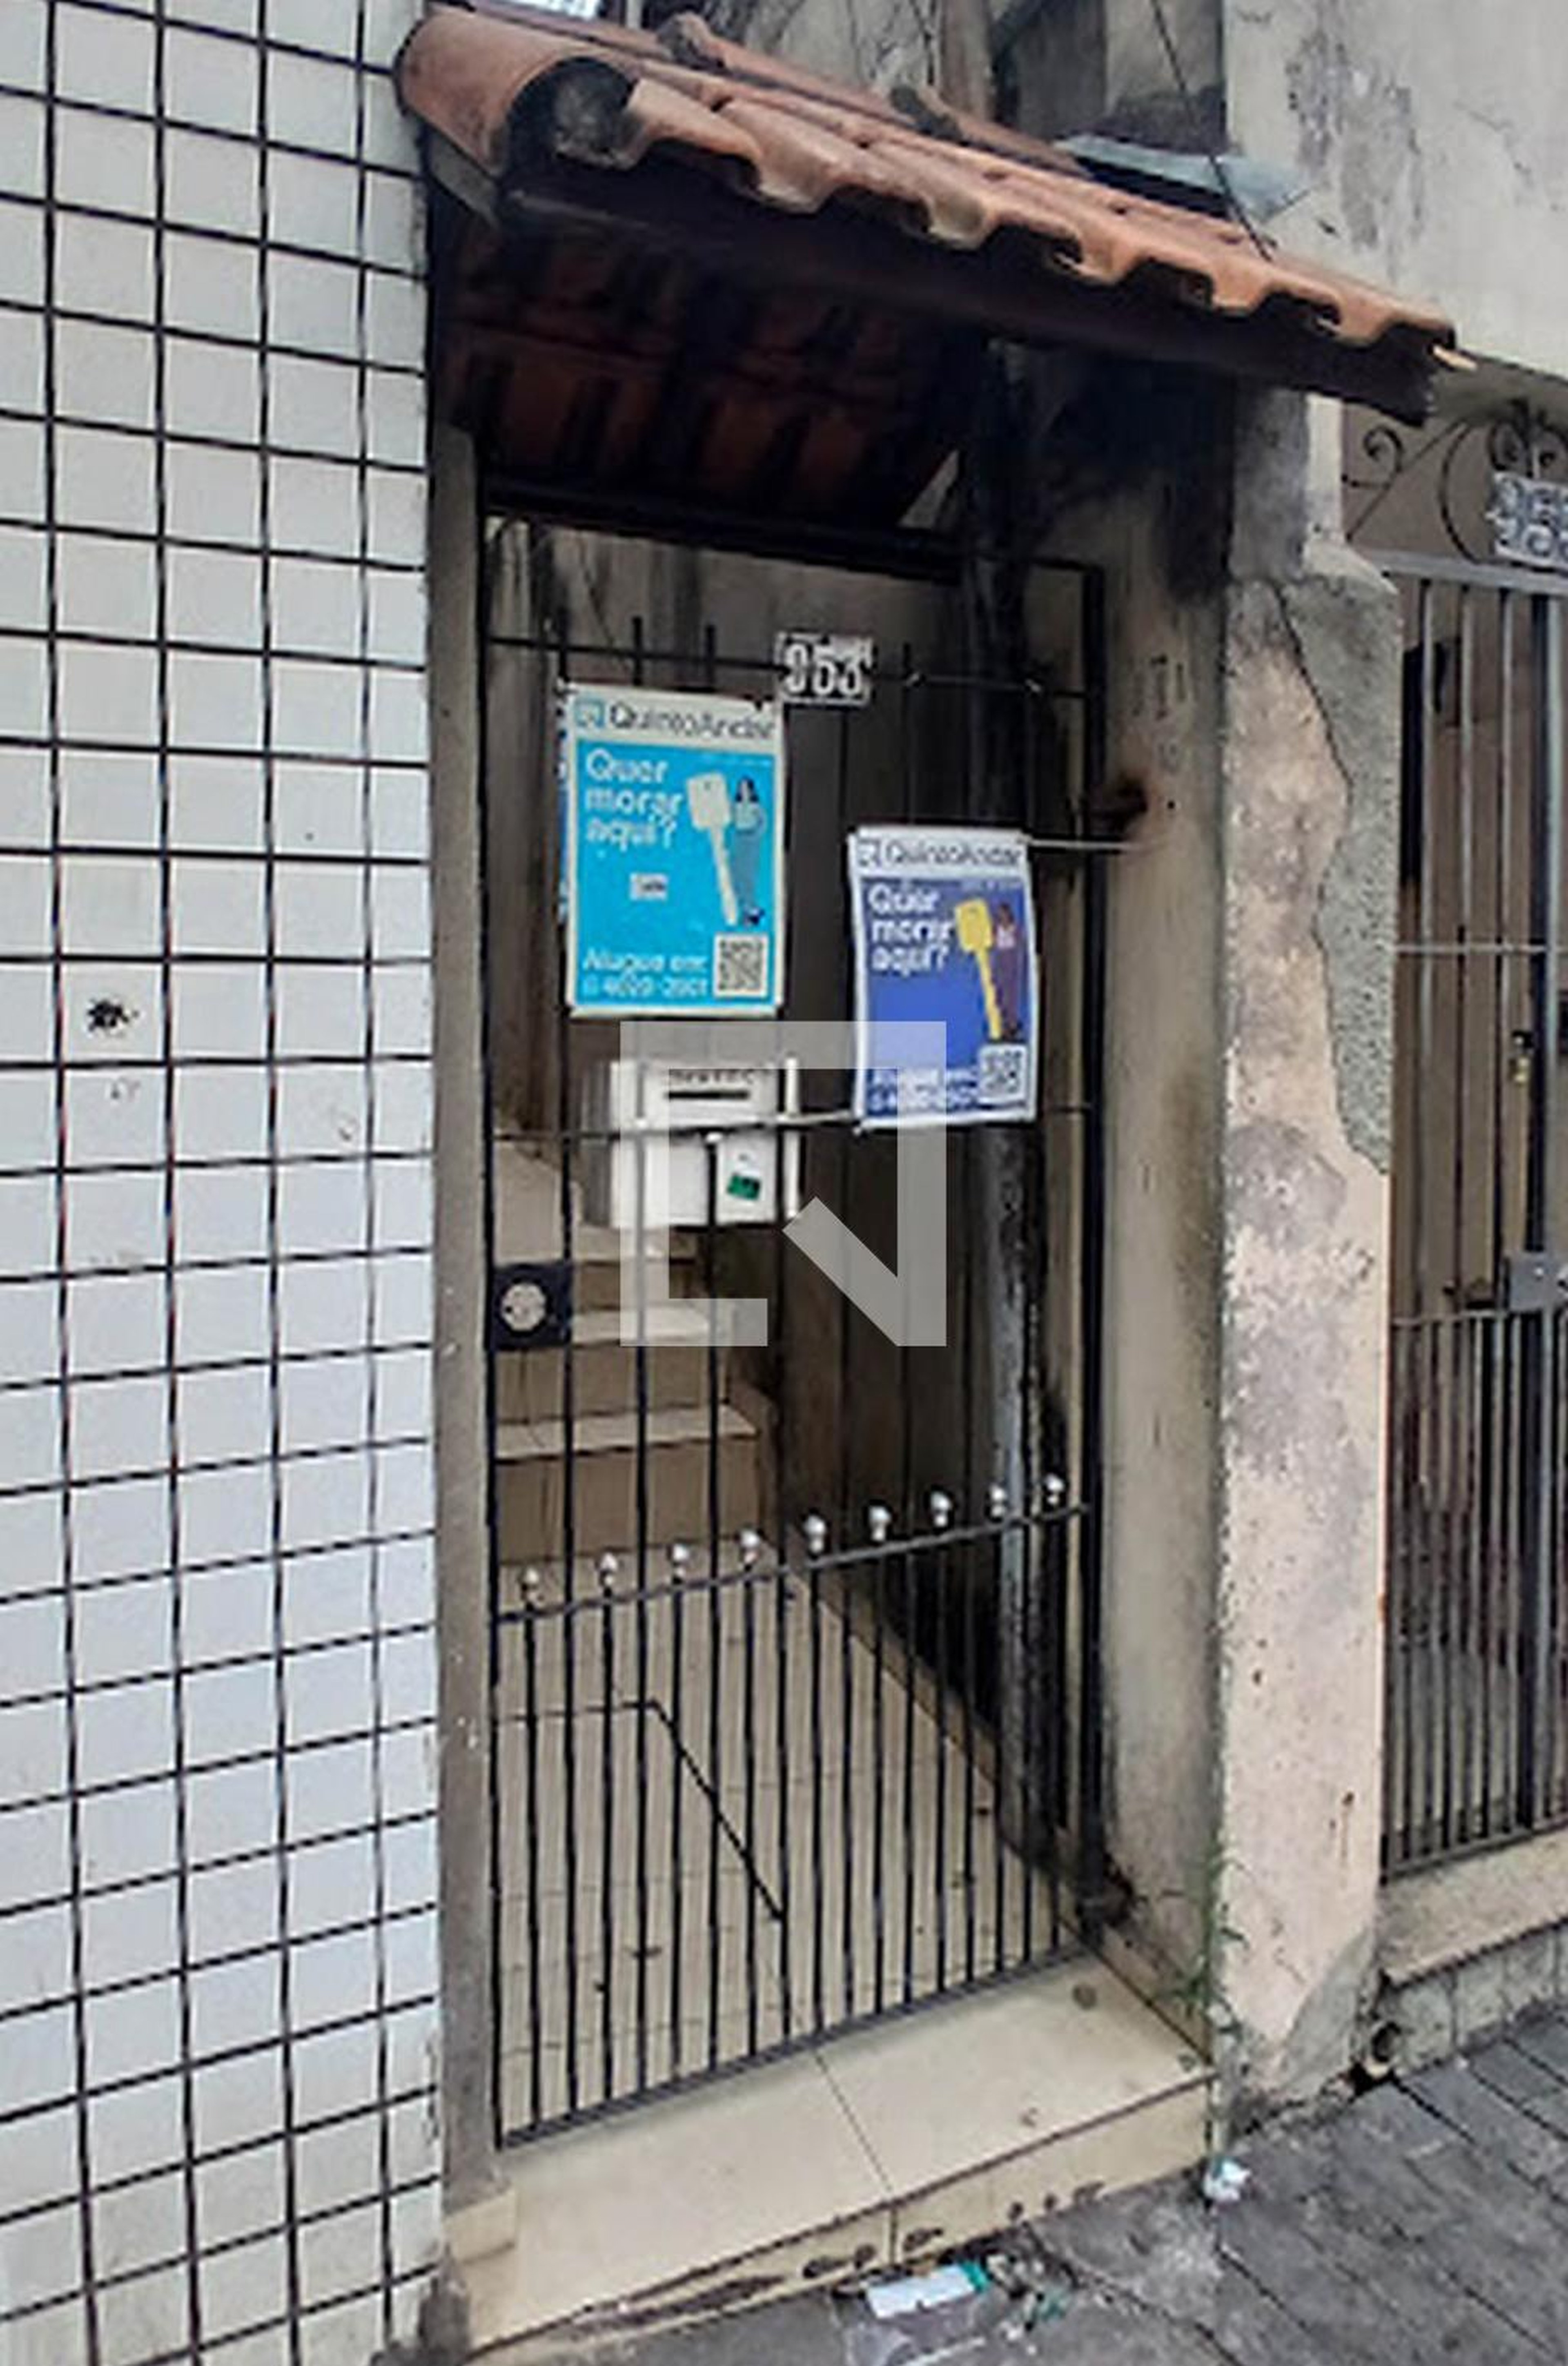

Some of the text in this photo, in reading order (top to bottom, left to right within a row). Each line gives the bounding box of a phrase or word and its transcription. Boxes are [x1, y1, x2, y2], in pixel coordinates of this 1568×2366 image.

[586, 747, 669, 784] Quer
[586, 787, 684, 817] morar
[586, 814, 679, 853] aqui?
[867, 883, 941, 915] Quer
